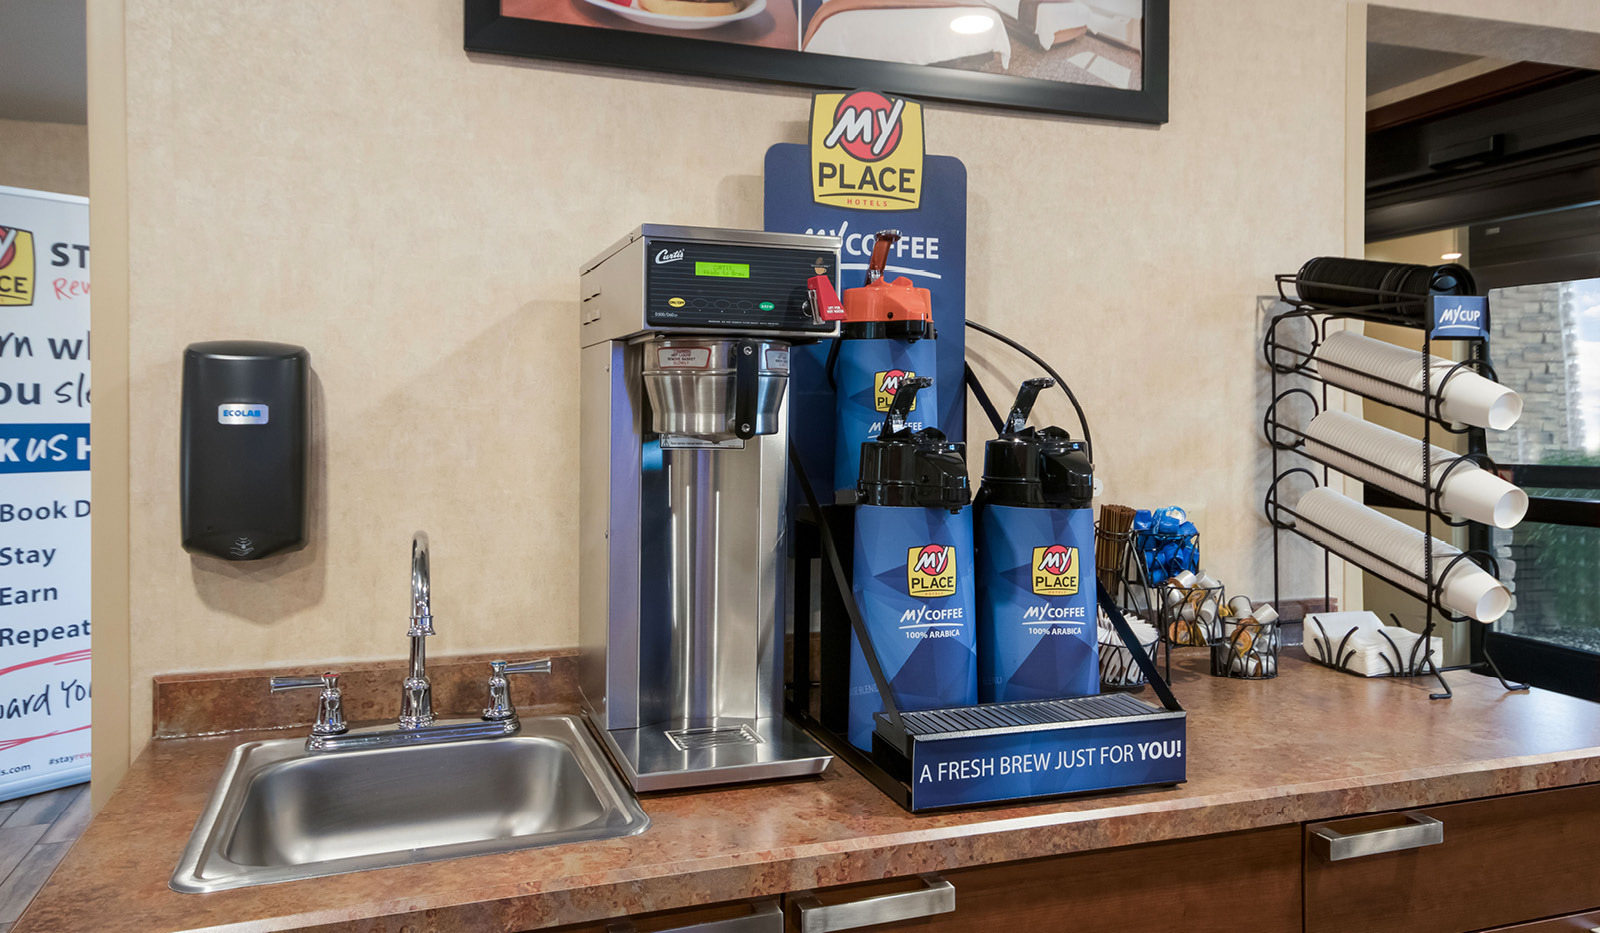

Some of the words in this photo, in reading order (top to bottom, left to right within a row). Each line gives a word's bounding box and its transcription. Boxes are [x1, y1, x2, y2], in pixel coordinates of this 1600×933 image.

[818, 162, 916, 194] PLACE
[847, 198, 888, 207] HOTELS
[655, 248, 684, 264] Curtis
[222, 409, 262, 418] ECOLAB
[0, 500, 68, 523] Book
[0, 547, 57, 568] Stay
[911, 576, 954, 589] PLACE
[1035, 576, 1077, 588] PLACE
[0, 586, 58, 606] Earn
[0, 619, 91, 648] Repeat
[905, 631, 929, 639] 100%
[929, 628, 961, 639] ARABICA
[1028, 627, 1051, 636] 100%
[1051, 627, 1082, 636] ARABICA
[919, 764, 933, 784] A
[938, 757, 995, 781] FRESH
[1000, 752, 1051, 775] BREW
[1055, 747, 1096, 770] JUST
[1100, 744, 1134, 765] FOR
[1137, 740, 1182, 761] YOU!
